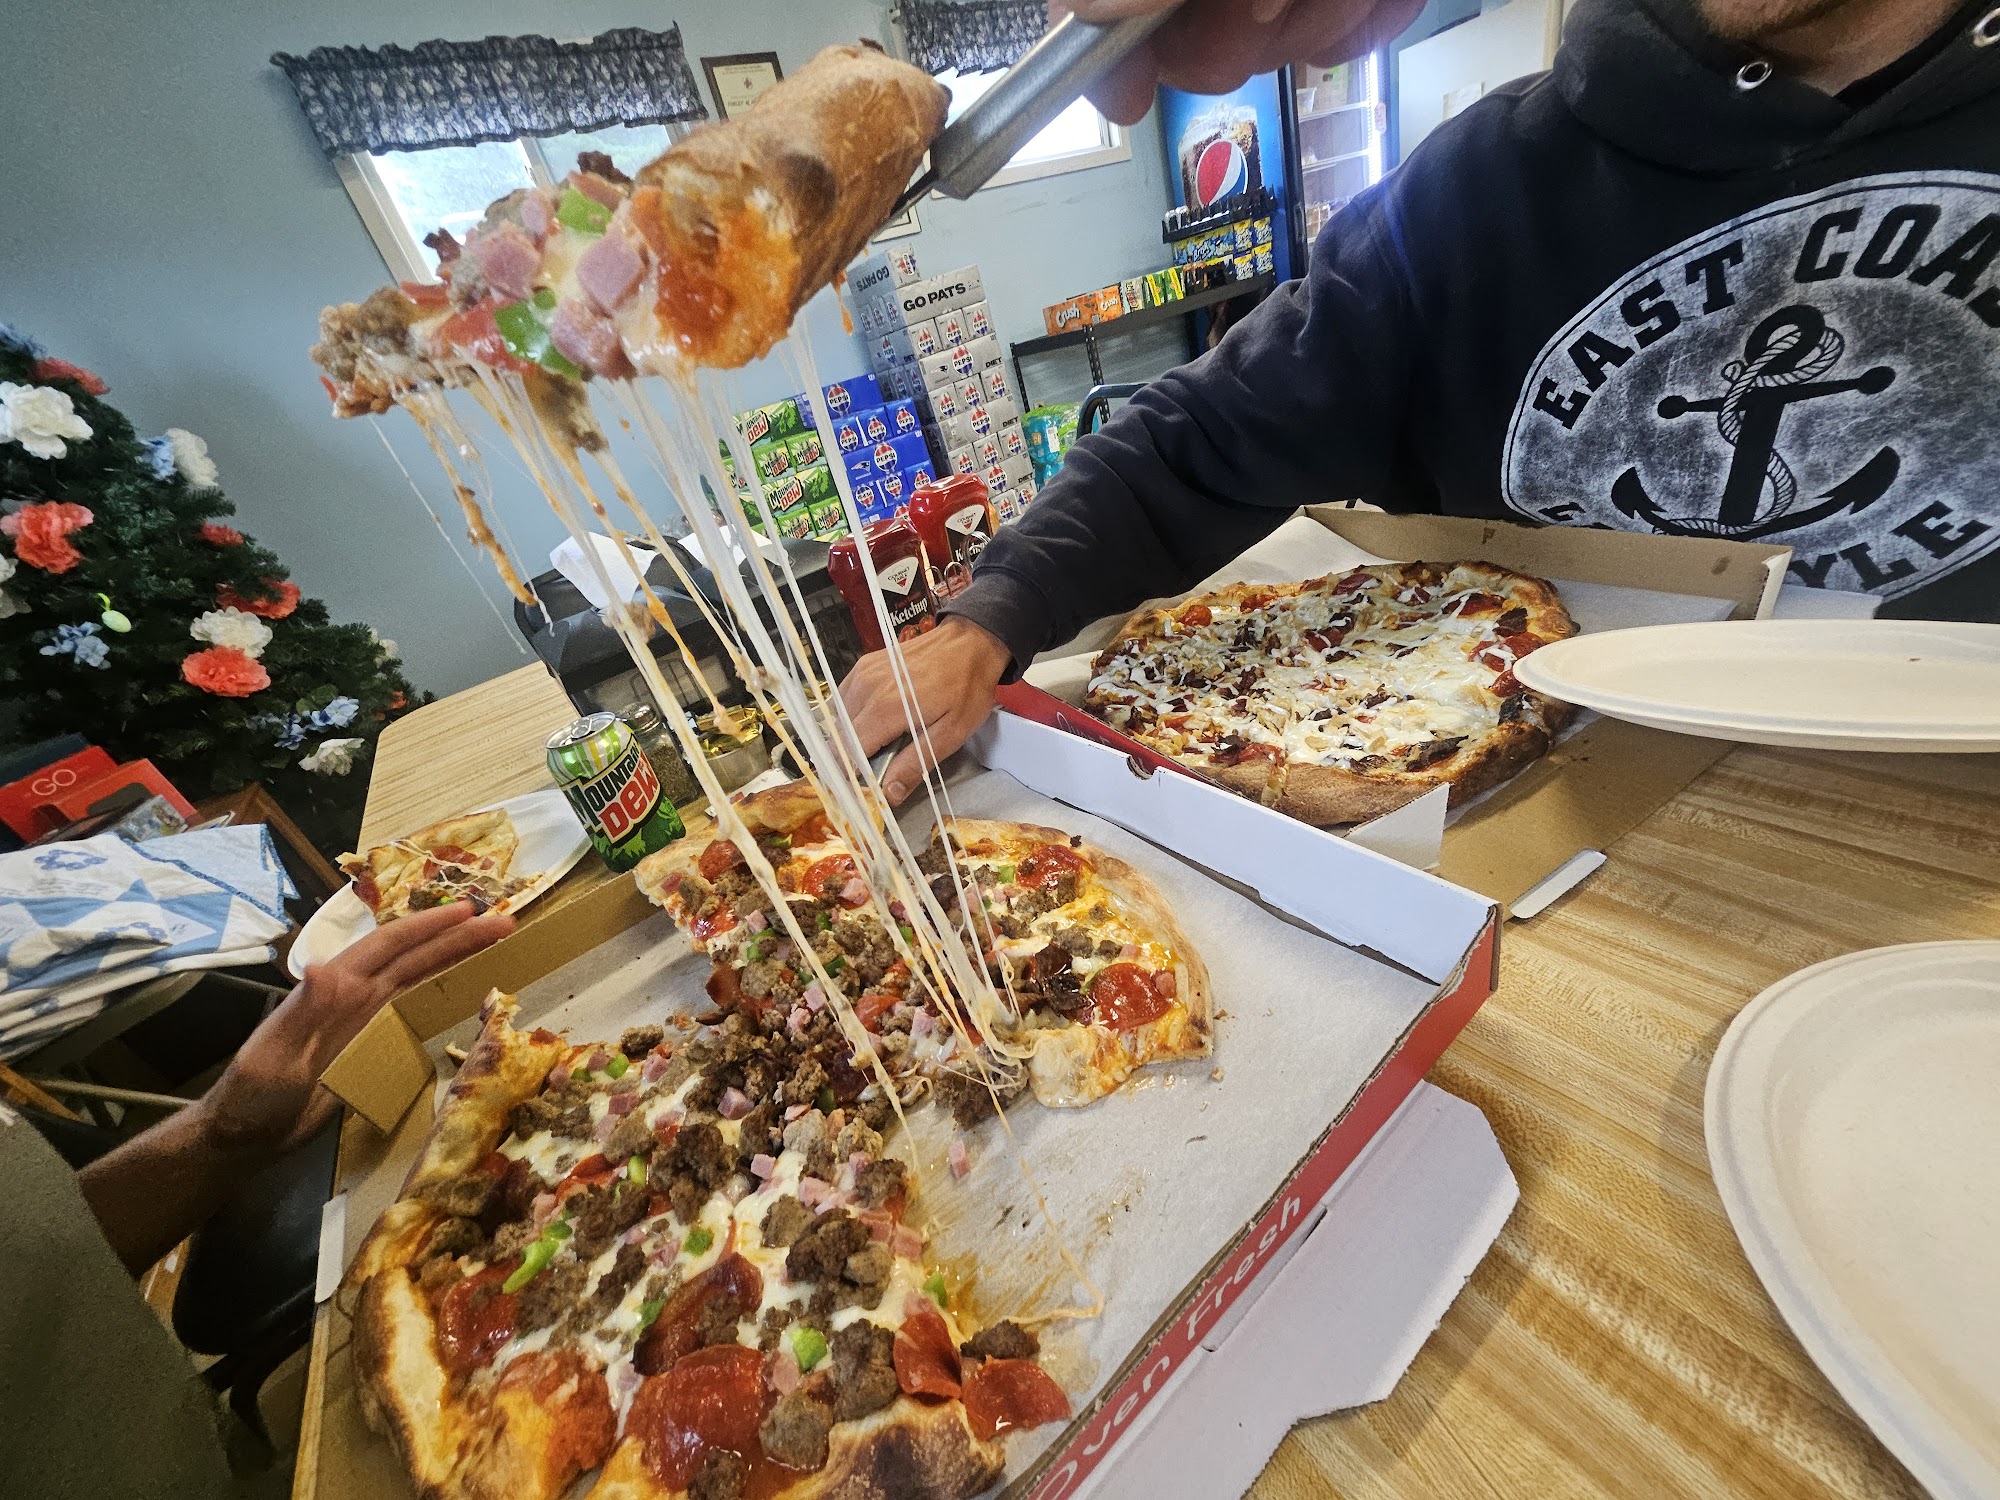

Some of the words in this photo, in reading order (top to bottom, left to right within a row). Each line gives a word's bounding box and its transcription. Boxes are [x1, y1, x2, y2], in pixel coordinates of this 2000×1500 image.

[876, 265, 890, 281] GO
[856, 272, 877, 292] PATS
[903, 296, 927, 312] GO
[927, 283, 966, 304] PATS
[1100, 296, 1118, 311] Crush
[1056, 303, 1080, 329] Crush
[1532, 239, 1743, 430] EAST
[953, 357, 973, 367] PEPSI
[985, 357, 1002, 368] DIET
[829, 395, 849, 405] PEPSI
[972, 417, 990, 427] PEPSI
[1002, 416, 1019, 427] DIET
[876, 453, 896, 463] PEPSI
[989, 474, 1006, 484] PEPSI
[890, 597, 928, 626] Ketchup
[32, 769, 77, 796] GO
[1037, 1355, 1170, 1500] Oven
[1186, 1197, 1301, 1341] Fresh
